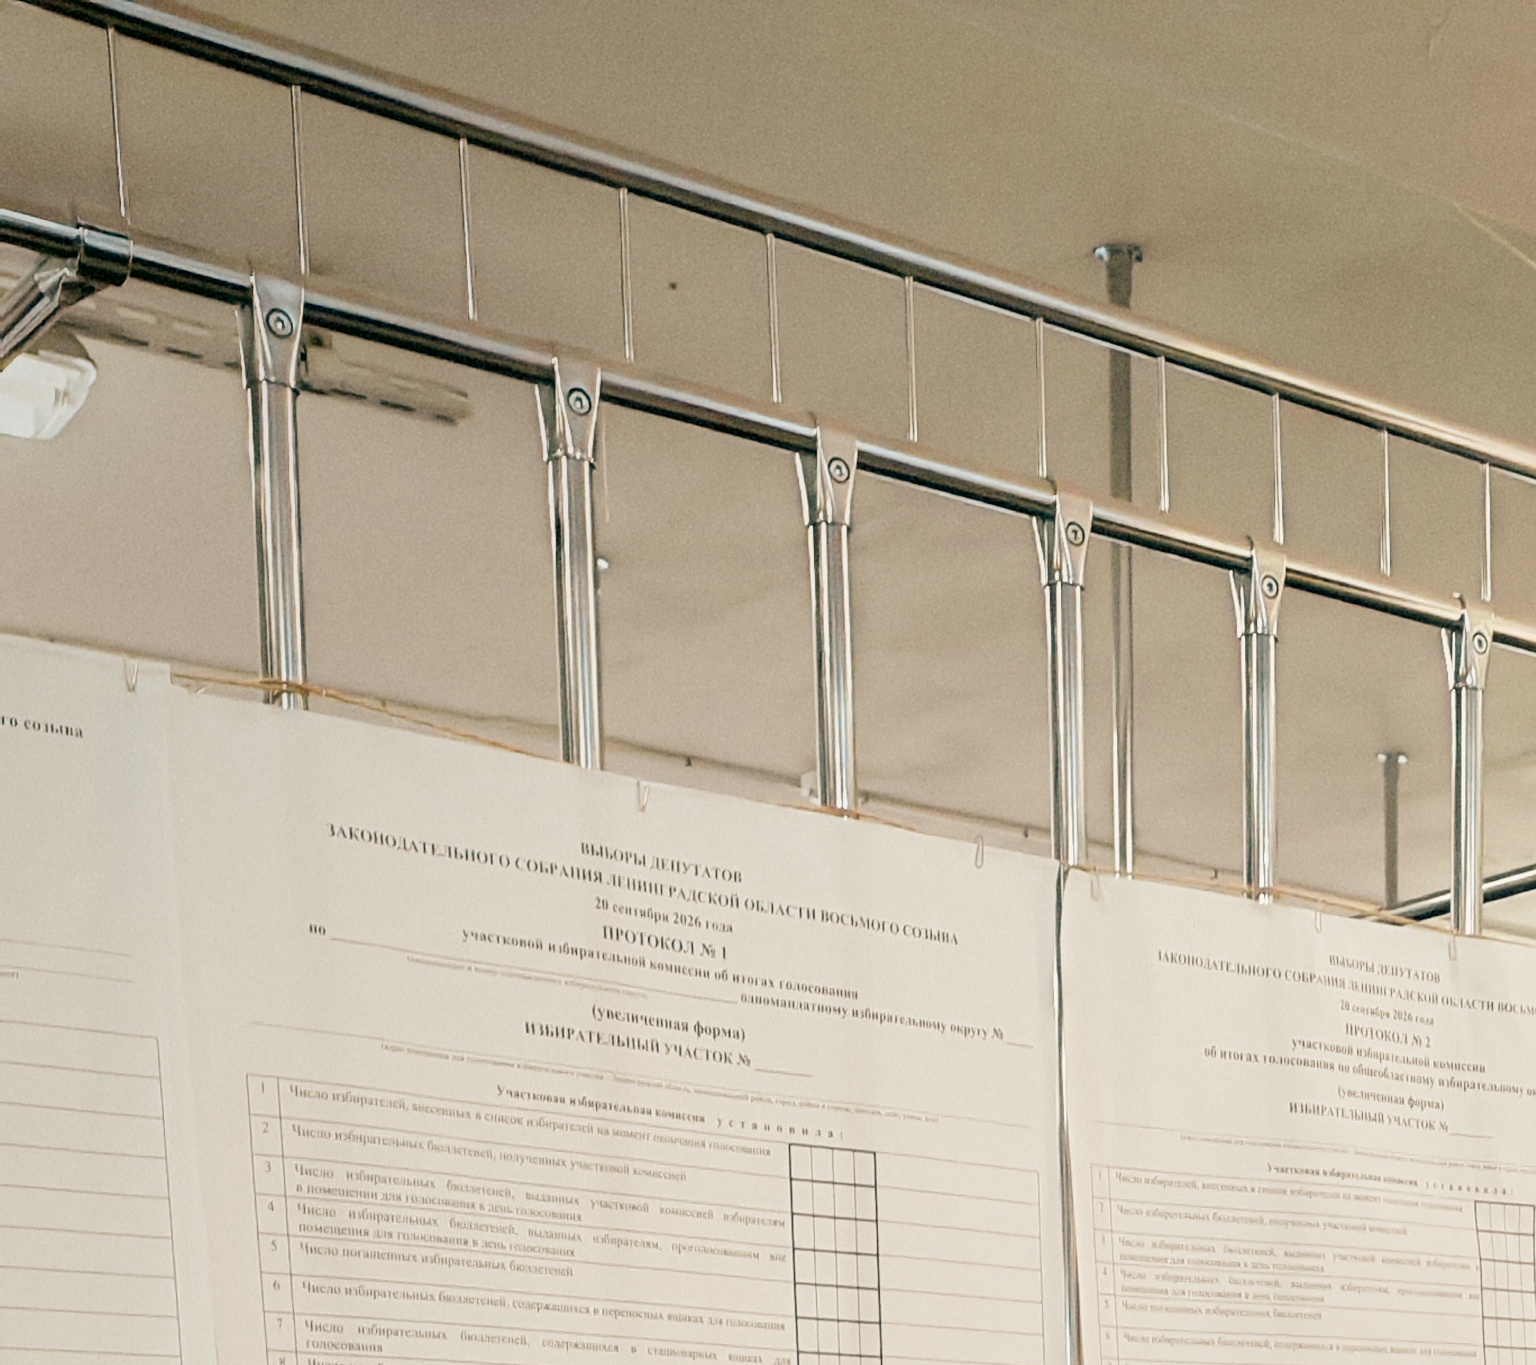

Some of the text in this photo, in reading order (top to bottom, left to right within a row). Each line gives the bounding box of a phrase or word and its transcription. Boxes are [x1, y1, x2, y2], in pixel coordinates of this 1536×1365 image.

[580, 841, 743, 884] ВЫБОРЫ ДЕПУТАТОВ
[325, 822, 960, 945] ЗАКОНОДАТЕЛЬНОГО СОБРАНИЯ ЛЕНИНГРАДСКОЙ ОБЛАСТИ ВОСЬМОГО СОЗЫВА
[308, 923, 327, 935] по
[594, 895, 734, 934] 20 сентября 2026 года
[602, 925, 727, 960] ПРОТОКОЛ № 1
[461, 928, 859, 1000] участковой избирательной комиссии об итогах голосования
[1328, 954, 1441, 984] ВЫБОРЫ ДЕПУТАТОВ
[1157, 950, 1282, 980] ЗАКОНОДАТЕЛЬНОГО
[1283, 968, 1346, 989] СОБРАНИЯ
[1348, 980, 1440, 1005] ЛЕНИНГРАДСКОЙ
[1440, 993, 1496, 1013] ОБЛАСТИ
[591, 1006, 746, 1043] (увеличенная форма)
[739, 992, 848, 1017] одномандатному
[850, 1008, 946, 1031] избирательному
[949, 1023, 988, 1040] округу
[524, 1021, 660, 1053] ИЗБИРАТЕЛЬНЫЙ
[664, 1042, 734, 1065] УЧАСТОК
[1344, 1023, 1409, 1045] ПРОТОКОЛ
[1424, 1035, 1431, 1049] 2
[1291, 1037, 1486, 1074] участковой избирательной комиссии
[496, 1087, 567, 1105] Участковая
[568, 1096, 654, 1116] избирательная
[654, 1109, 706, 1123] комиссия
[1288, 1100, 1385, 1124] ИЗБИРАТЕЛЬНЫЙ
[1386, 1114, 1436, 1131] УЧАСТОК
[1336, 1087, 1445, 1112] (увеличенная форма)
[262, 1122, 269, 1134] 2
[265, 1161, 271, 1173] 3
[268, 1201, 274, 1212] 4
[271, 1240, 277, 1252] 5
[273, 1280, 280, 1291] 6
[277, 1318, 282, 1329] 7
